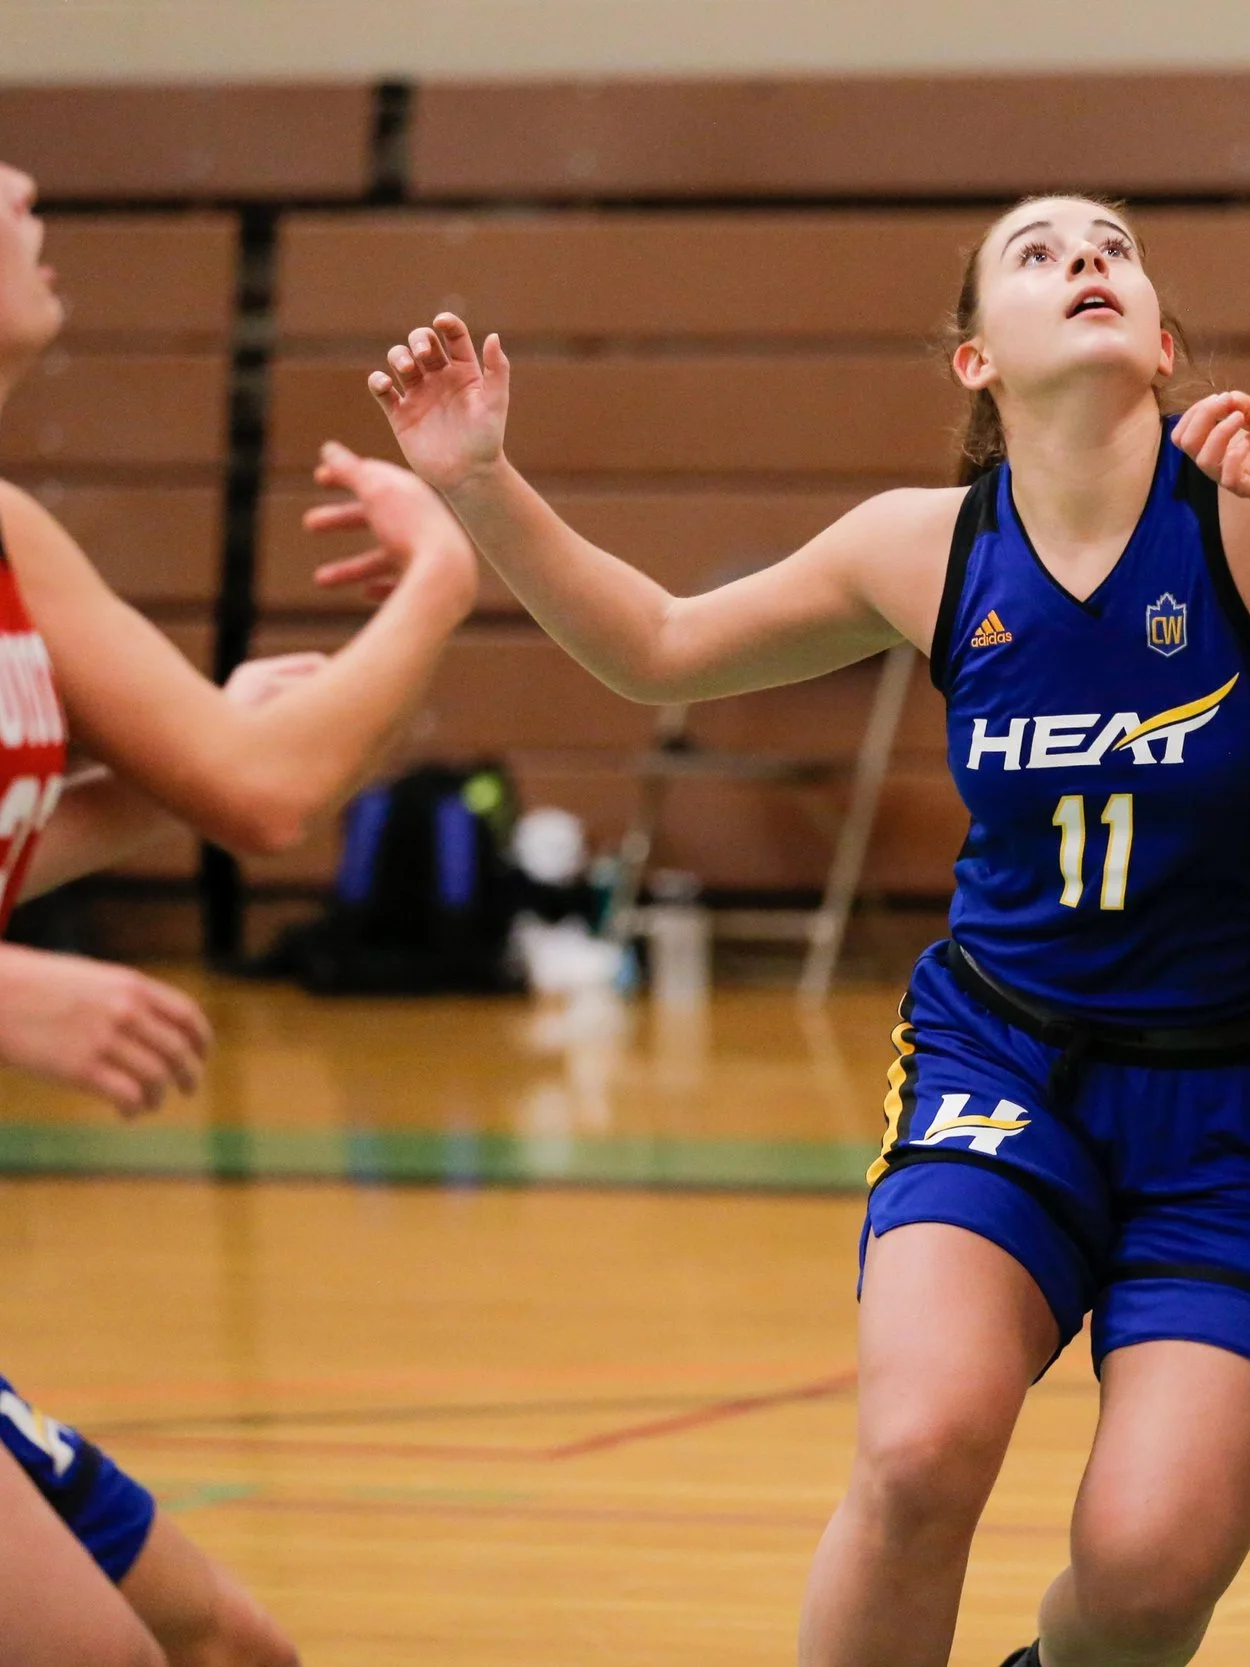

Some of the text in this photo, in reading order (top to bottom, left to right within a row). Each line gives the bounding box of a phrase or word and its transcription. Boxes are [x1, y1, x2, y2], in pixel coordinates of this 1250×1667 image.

[970, 632, 1013, 648] adidas
[1151, 614, 1184, 645] CW
[966, 690, 1230, 771] HEAT
[1052, 793, 1134, 911] 11
